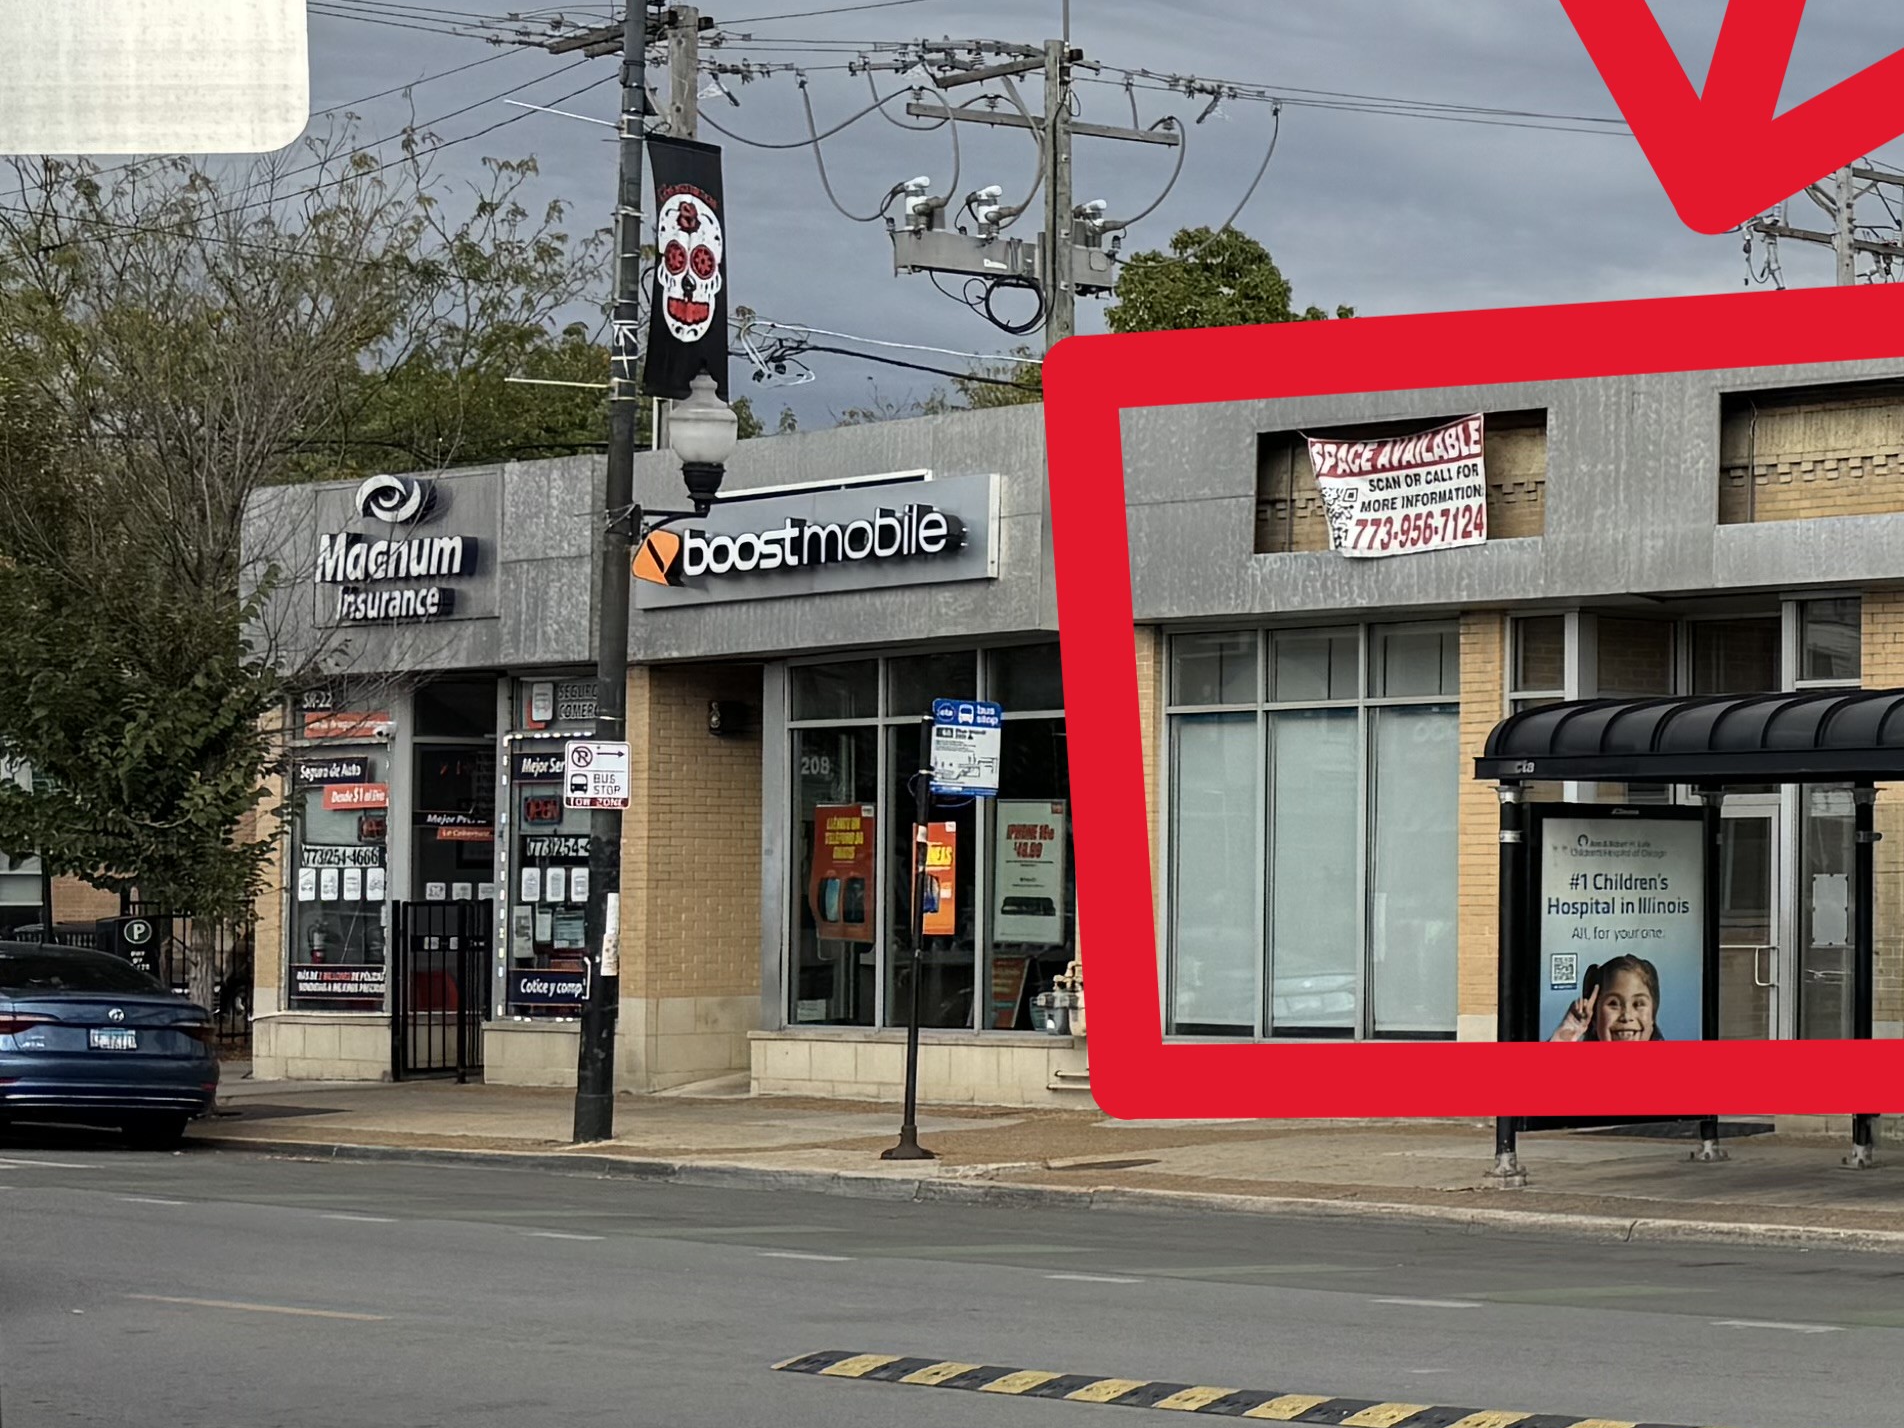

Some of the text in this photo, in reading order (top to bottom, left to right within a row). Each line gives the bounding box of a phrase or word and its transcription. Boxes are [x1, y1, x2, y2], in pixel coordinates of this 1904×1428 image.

[1310, 419, 1482, 475] SPACE AVAILABLE
[1368, 463, 1479, 492] SCAN OR CALL FOR
[1360, 497, 1397, 513] MORE
[1352, 503, 1484, 550] 773-956-7124
[315, 531, 463, 583] Magnum
[336, 585, 441, 620] Insurance
[977, 705, 995, 715] bus
[977, 716, 999, 726] stop
[522, 757, 548, 777] Mejor
[801, 756, 831, 775] 208
[593, 774, 616, 784] BUS
[593, 785, 621, 795] STOP
[1570, 873, 1668, 891] #1 Children's
[1547, 897, 1690, 919] Hospital in Illinois
[1593, 927, 1611, 940] for
[520, 978, 583, 998] Cotice y comp
